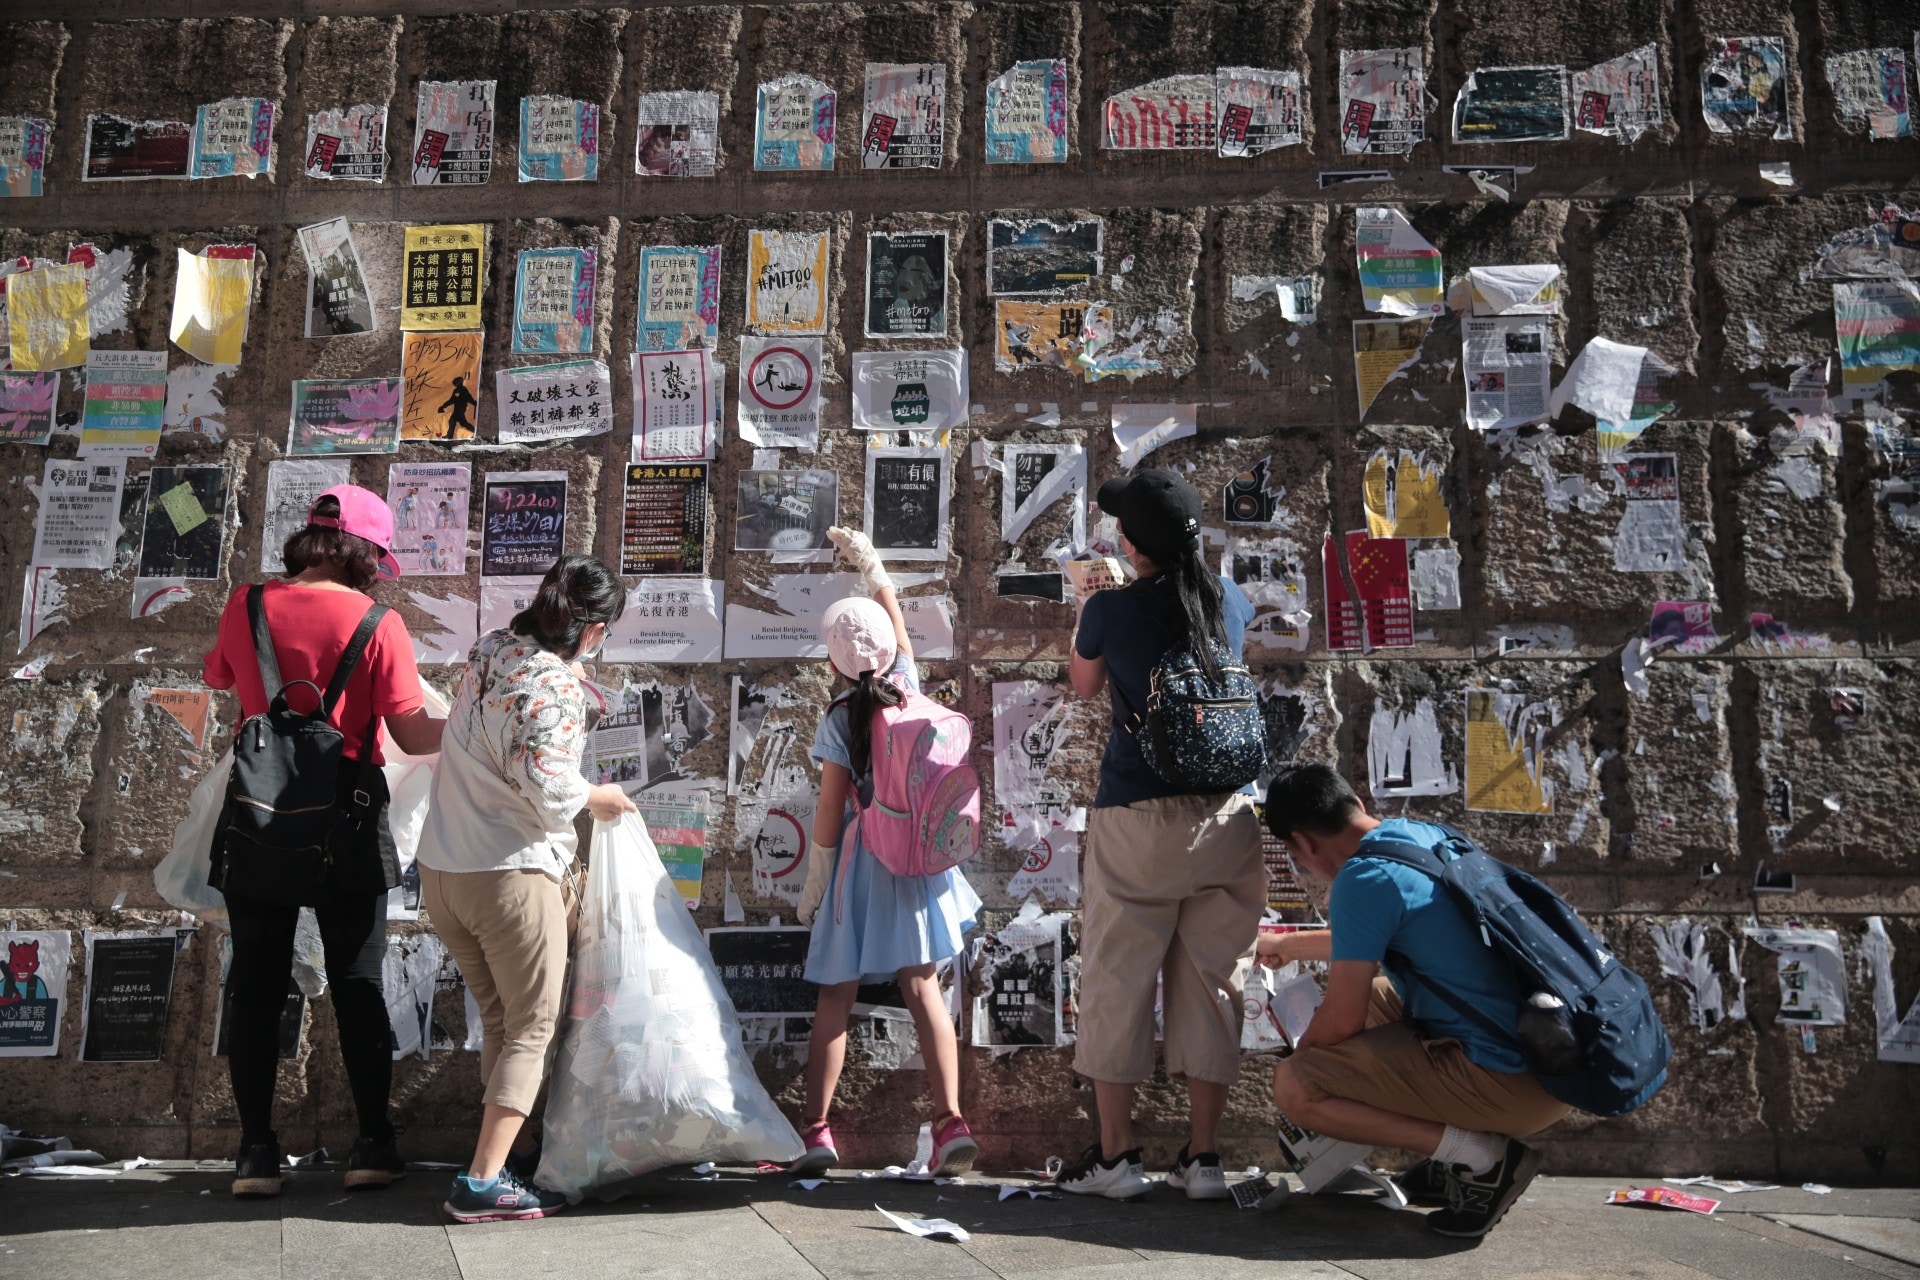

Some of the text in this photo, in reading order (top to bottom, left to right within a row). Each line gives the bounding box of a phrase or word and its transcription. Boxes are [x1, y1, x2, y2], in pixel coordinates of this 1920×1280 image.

[419, 234, 470, 245] 用完必棄
[411, 254, 425, 305] 大限將至
[426, 253, 440, 304] 錯判時局
[446, 252, 459, 304] 背棄公義
[460, 252, 474, 303] 無知黑警
[755, 267, 812, 291] #METOO
[416, 311, 467, 321] 拿來祭旗
[885, 303, 930, 318] #metoo
[95, 354, 128, 362] 五大訴求
[509, 380, 600, 404] 又破壞文宣
[895, 404, 926, 417] 垃圾
[781, 413, 817, 423] 欺凌弱小
[881, 463, 935, 482] 良知有價
[1016, 454, 1032, 492] 勿忘
[638, 605, 689, 618] 光復香港
[661, 630, 686, 639] Beijing,
[783, 626, 809, 634] Beijing,
[658, 638, 676, 646] Hong
[677, 638, 697, 646] Kong.
[780, 633, 798, 641] Hong
[799, 633, 819, 641] Kong.
[1260, 700, 1288, 713] ONE
[1266, 713, 1288, 725] ELT
